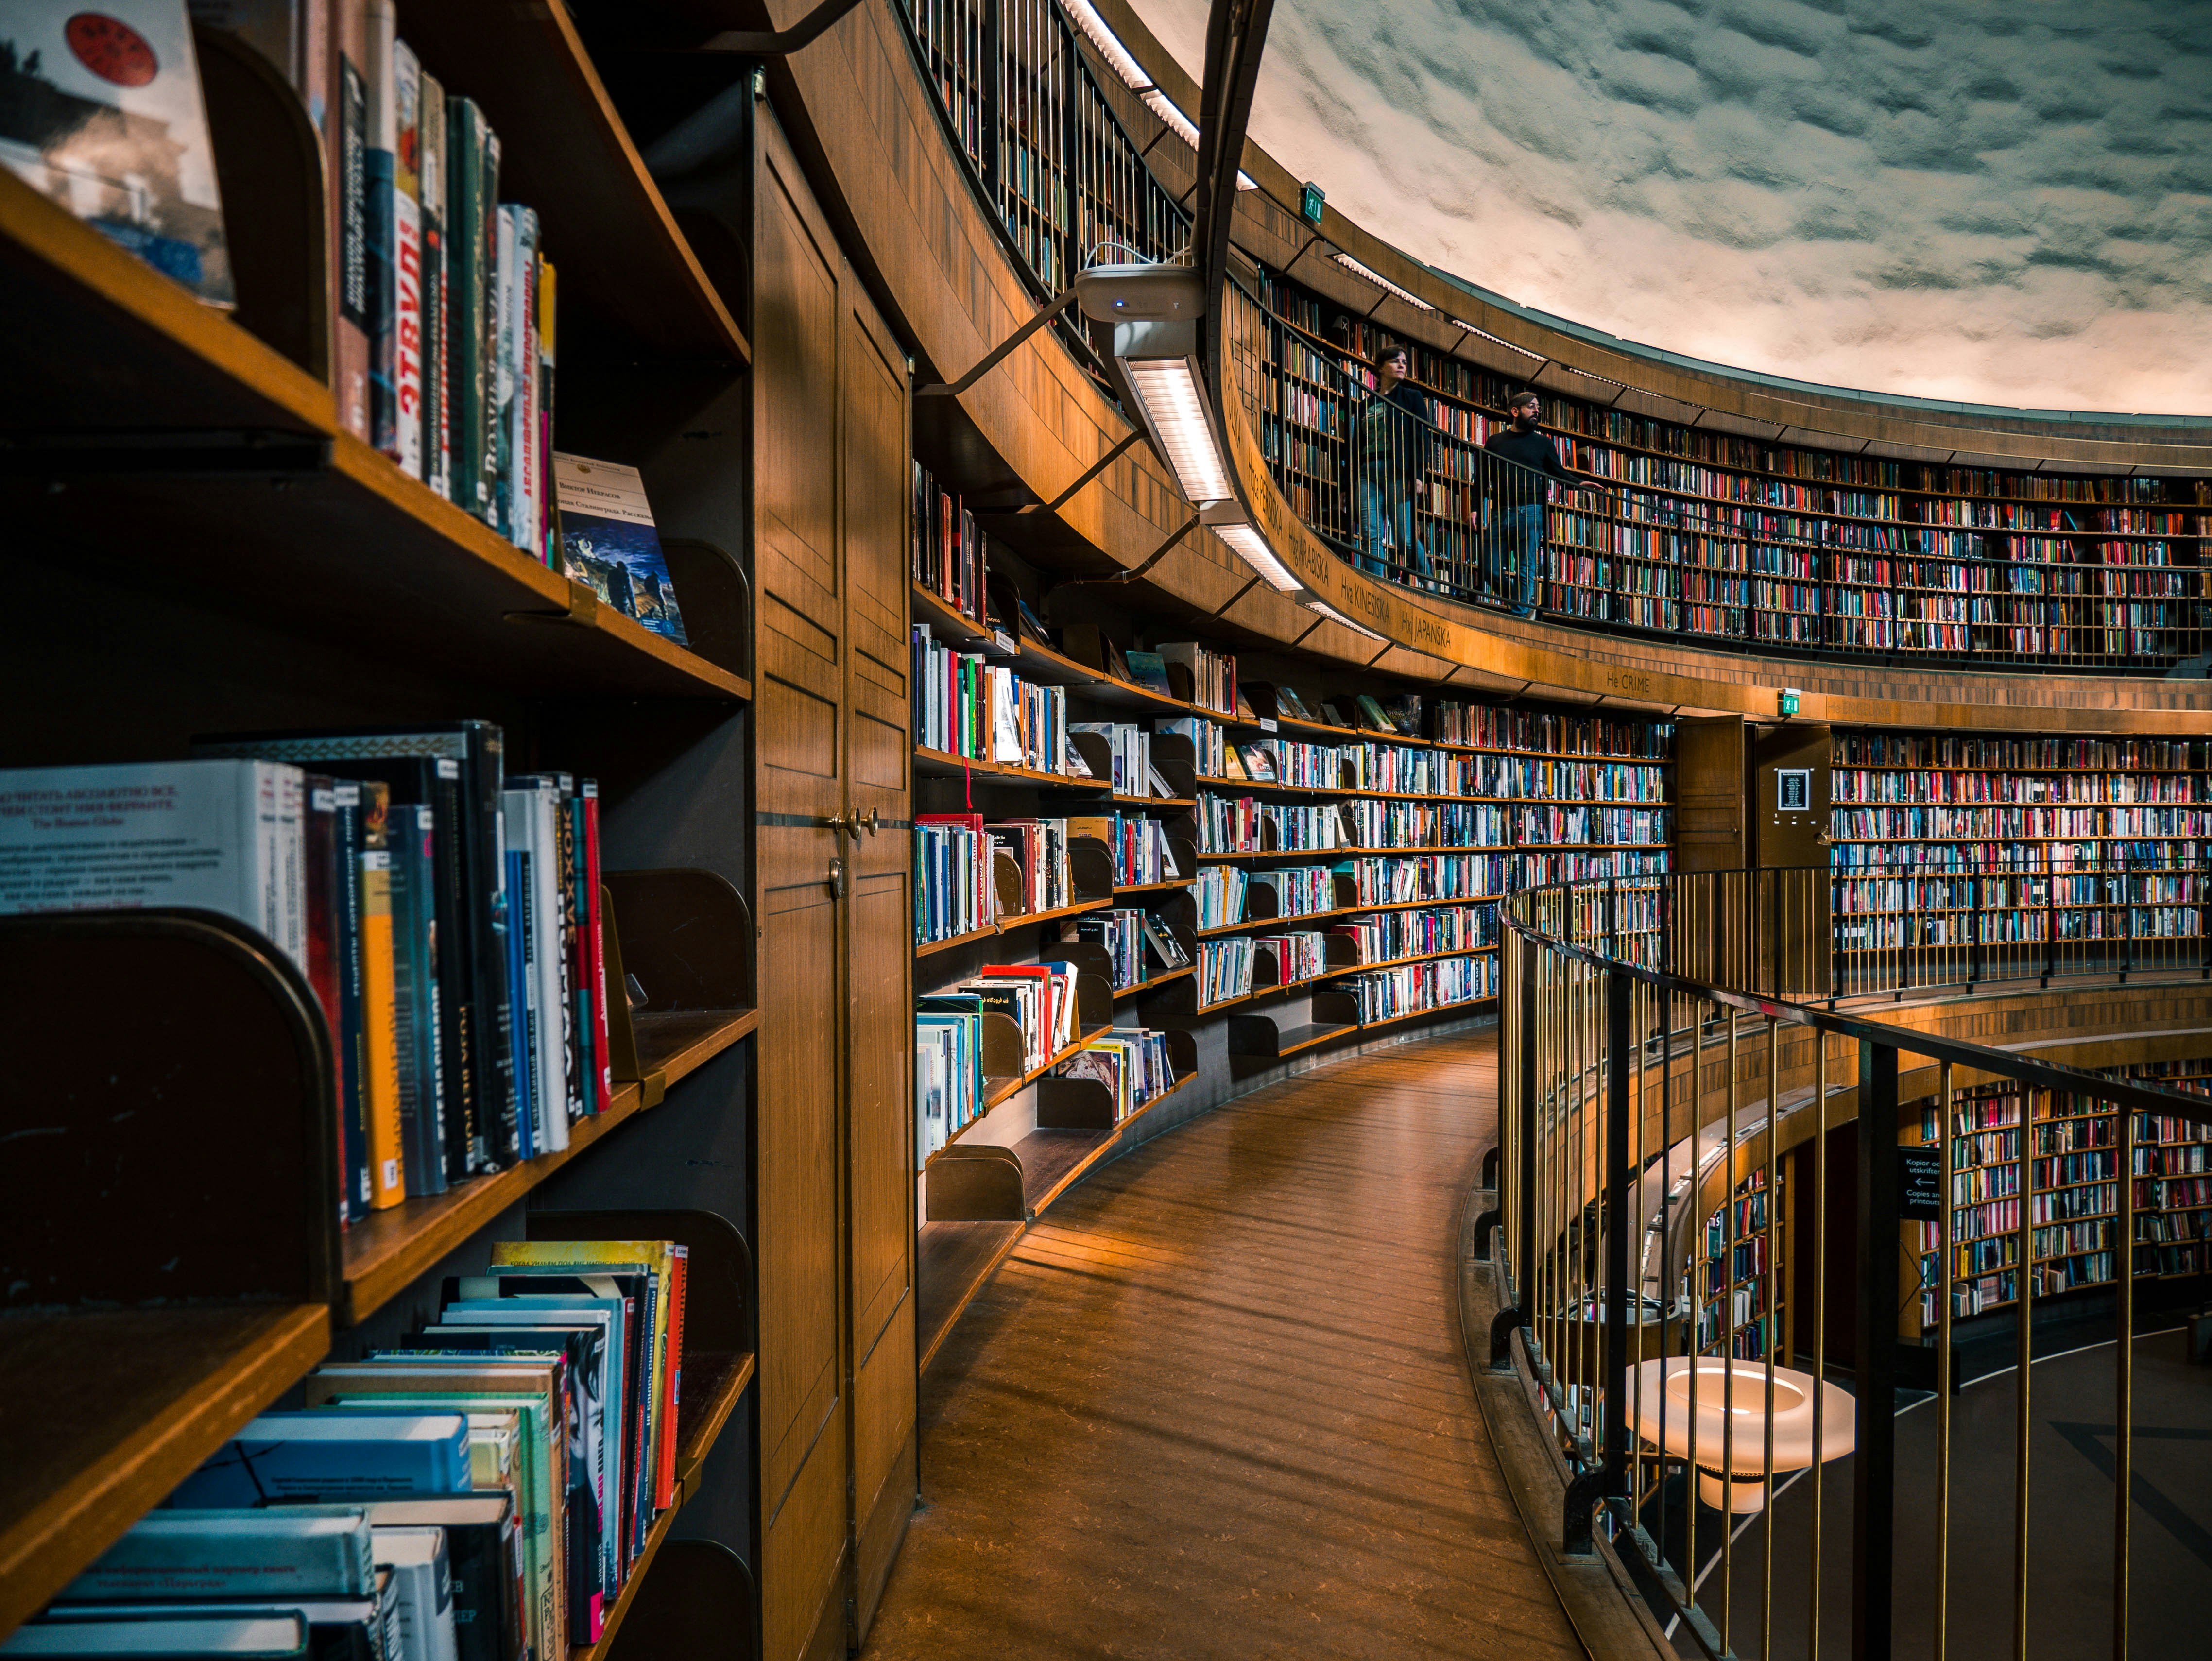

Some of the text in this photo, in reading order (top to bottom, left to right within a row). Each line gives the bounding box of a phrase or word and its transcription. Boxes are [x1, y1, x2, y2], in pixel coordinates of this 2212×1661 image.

[1343, 322, 1348, 331] X
[1260, 476, 1284, 540] PERSISKA
[1288, 522, 1329, 587] Hsg ARABISKA
[1341, 574, 1390, 625] Hva KINESISKA
[1402, 612, 1451, 650] Hxj JAPANSKA
[1607, 671, 1649, 693] He CRIME
[1969, 744, 1974, 753] C
[2075, 847, 2080, 856] E
[2106, 880, 2112, 889] G
[1926, 921, 1932, 929] D
[1924, 1071, 1940, 1089] HIS
[1906, 1159, 1930, 1167] Kopior
[1906, 1189, 1930, 1198] Copies
